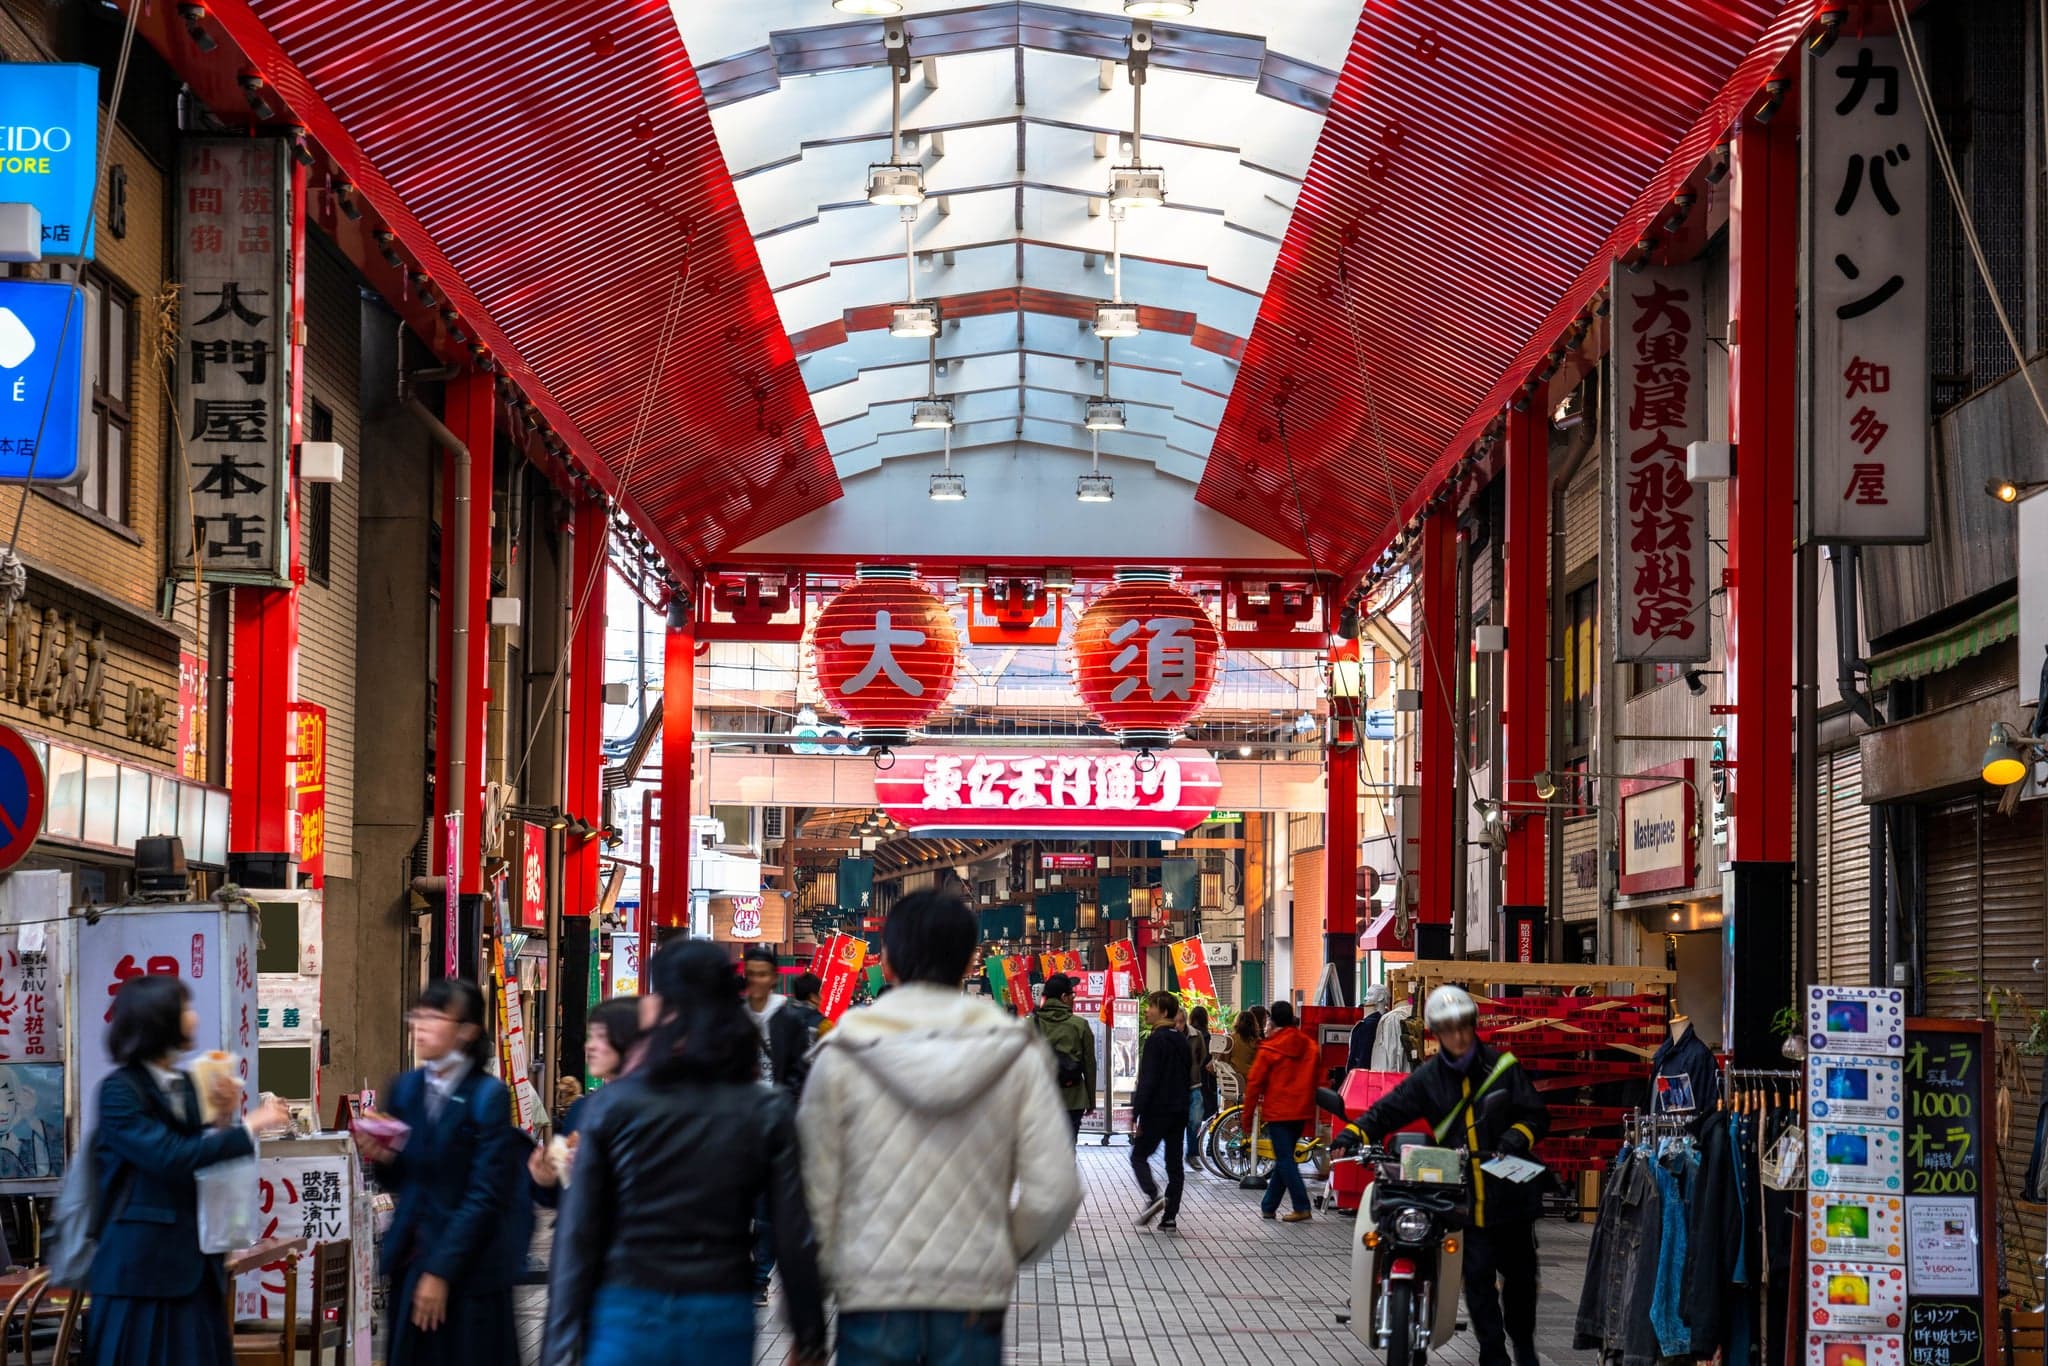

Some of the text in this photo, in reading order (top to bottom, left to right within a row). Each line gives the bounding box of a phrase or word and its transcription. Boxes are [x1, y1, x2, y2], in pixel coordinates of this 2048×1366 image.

[188, 149, 224, 255] 小間物
[237, 149, 274, 254] 化粧品
[1836, 48, 1910, 320] カバン
[186, 281, 268, 559] 大門屋本店
[1844, 356, 1890, 505] 知多屋
[841, 610, 926, 697] 大
[1109, 617, 1196, 702] 須
[1633, 813, 1675, 853] Masterpiece
[23, 994, 46, 1055] 化粧品
[1904, 1041, 1972, 1079] オーラ
[1907, 1124, 1971, 1168] オーラ
[1912, 1169, 1977, 1193] 2000
[1914, 1309, 1959, 1325] ヒーリング
